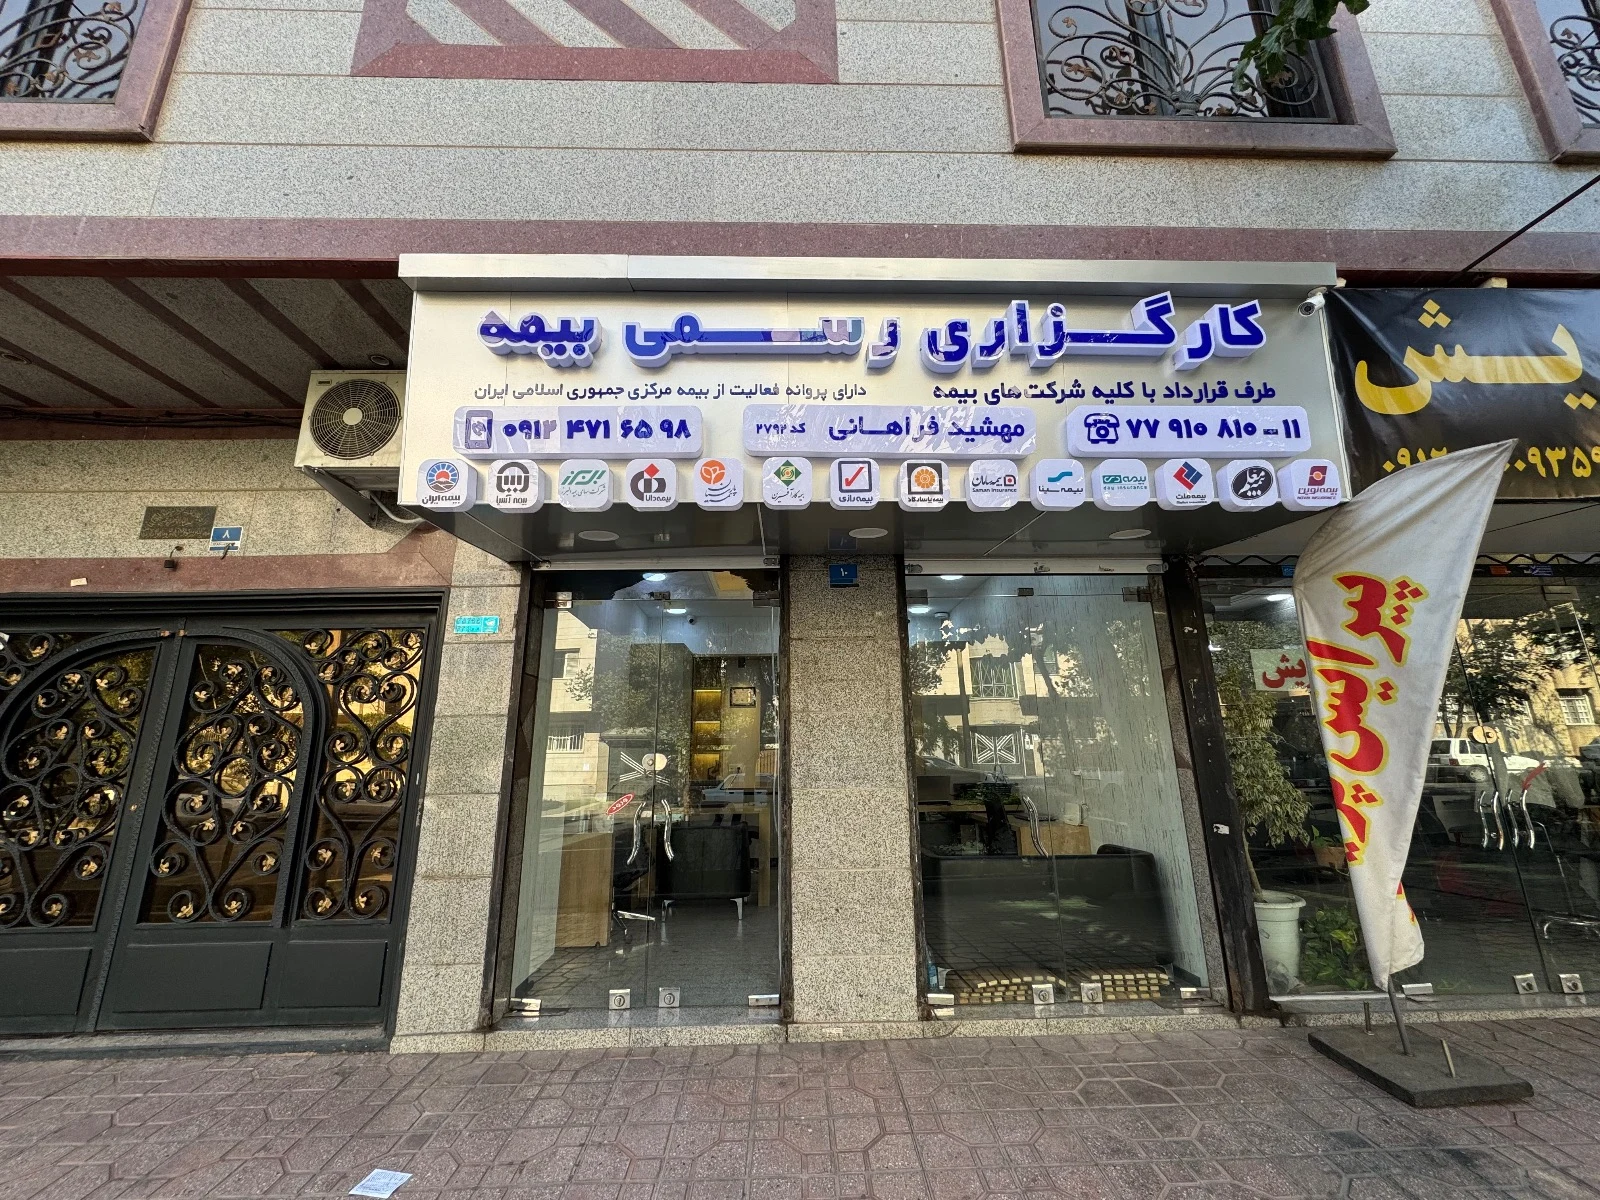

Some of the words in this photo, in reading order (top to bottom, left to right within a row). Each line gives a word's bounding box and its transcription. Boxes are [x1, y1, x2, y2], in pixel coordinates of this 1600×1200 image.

[476, 309, 604, 366] بیمه
[474, 383, 509, 400] ایران
[512, 383, 564, 400] اسلامی
[566, 384, 625, 401] جمهوری
[627, 382, 673, 401] مرکزی
[676, 384, 710, 400] بیمه
[712, 383, 725, 400] از
[729, 383, 780, 400] فعالیت
[785, 383, 828, 402] پروانه
[832, 383, 867, 401] دارای
[932, 383, 977, 405] بیمه
[1091, 381, 1135, 404] کلیه
[1141, 381, 1155, 403] با
[1163, 380, 1228, 404] قرارداد
[1235, 380, 1276, 402] طرف
[566, 419, 611, 440] ۴۷۱
[620, 418, 654, 440] ۶۵
[659, 418, 692, 440] ۹۸
[790, 422, 806, 434] کد
[828, 416, 940, 442] فراهانی
[947, 416, 1026, 444] مهشید
[1126, 418, 1161, 439] ۷۷
[1168, 418, 1208, 439] ۹۱۰
[1217, 418, 1258, 439] ۸۱۰
[1122, 474, 1147, 486] بیمه
[645, 494, 656, 502] دانا
[838, 494, 856, 503] رازی
[1038, 485, 1060, 495] سینا
[1060, 486, 1084, 495] بیمه
[1298, 486, 1319, 496] نوین
[1319, 487, 1339, 496] بیمه
[421, 494, 440, 505] ایران
[441, 494, 461, 505] بیمه
[495, 494, 512, 506] آسیا
[512, 496, 528, 506] بیمه
[856, 495, 874, 504] بیمه
[222, 529, 230, 539] ۸
[840, 567, 848, 577] ۱۰
